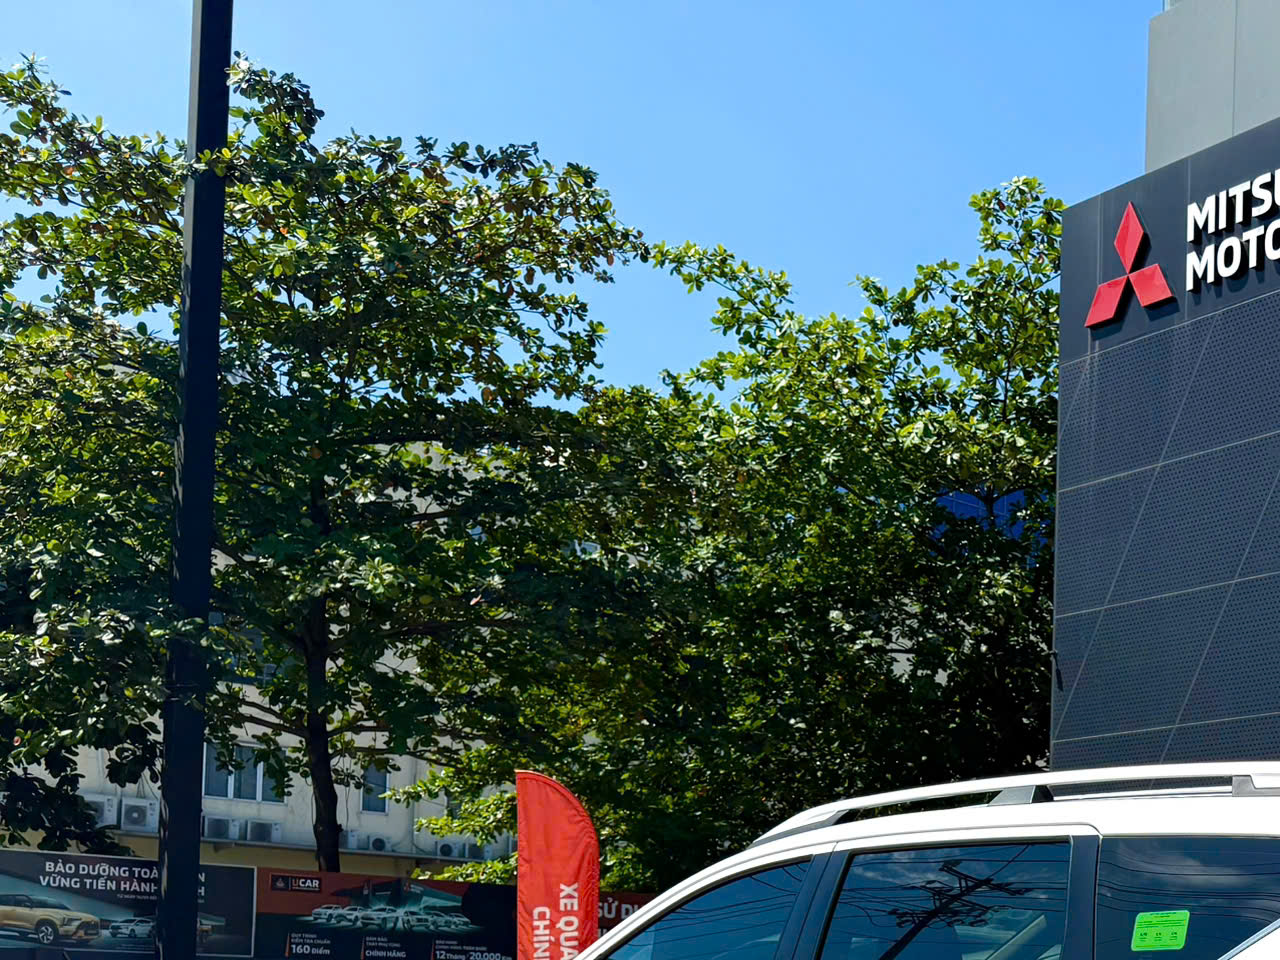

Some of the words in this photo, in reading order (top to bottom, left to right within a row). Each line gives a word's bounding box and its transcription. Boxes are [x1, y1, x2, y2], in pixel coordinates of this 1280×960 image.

[45, 859, 75, 874] BẢO
[79, 862, 129, 877] DƯỠNG
[132, 864, 159, 878] TOÀ
[39, 873, 80, 889] VỮNG
[84, 876, 117, 891] TIẾN
[292, 879, 320, 889] UCAR
[560, 883, 578, 912] XE
[291, 944, 311, 954] 160
[436, 951, 446, 959] 12
[469, 952, 501, 960] 20.000
